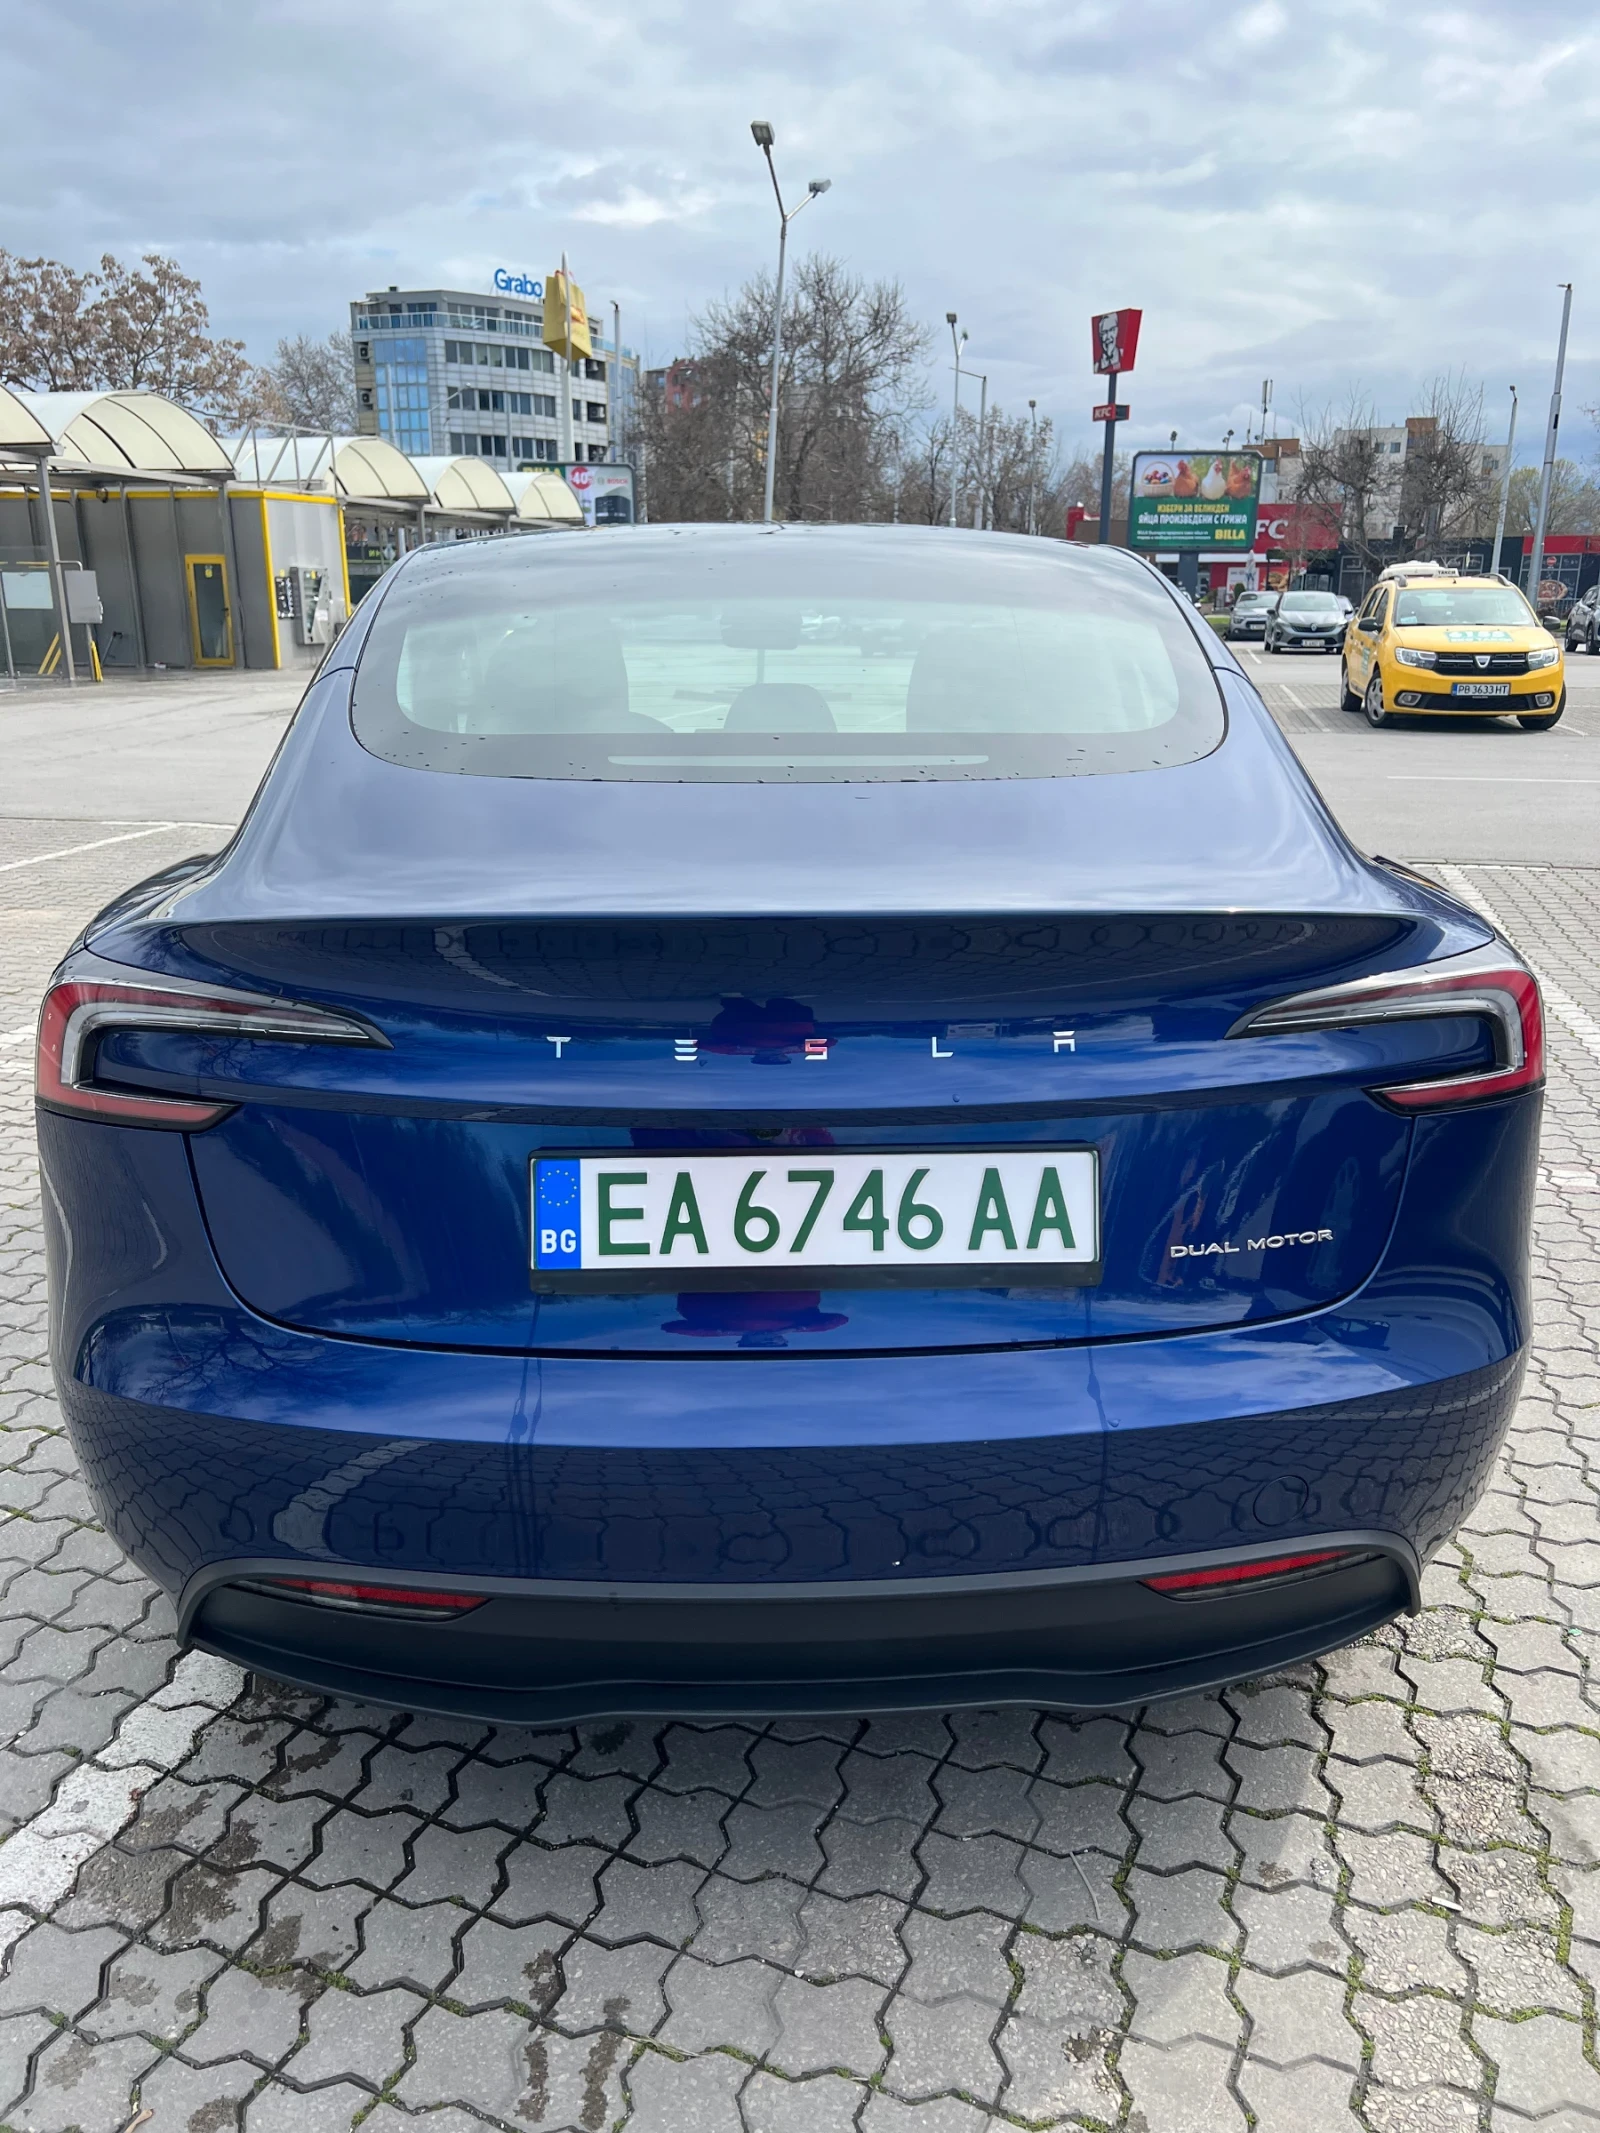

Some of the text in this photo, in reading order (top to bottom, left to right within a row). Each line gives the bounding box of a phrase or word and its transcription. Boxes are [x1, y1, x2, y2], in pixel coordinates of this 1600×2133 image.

[494, 268, 542, 297] Grabo
[1094, 407, 1112, 418] KFC
[1184, 504, 1193, 513] ЗА
[1138, 512, 1248, 525] ЯЙЦА ПРОИЗВЕДЕНИ С ГРИЖА
[1215, 529, 1246, 540] BILLA
[1255, 519, 1289, 539] FC
[1458, 685, 1508, 694] PB 3633 HT
[598, 1166, 1076, 1255] EA 6746 AA
[541, 1229, 577, 1254] BG
[1170, 1229, 1334, 1258] DUAL MOTOR
